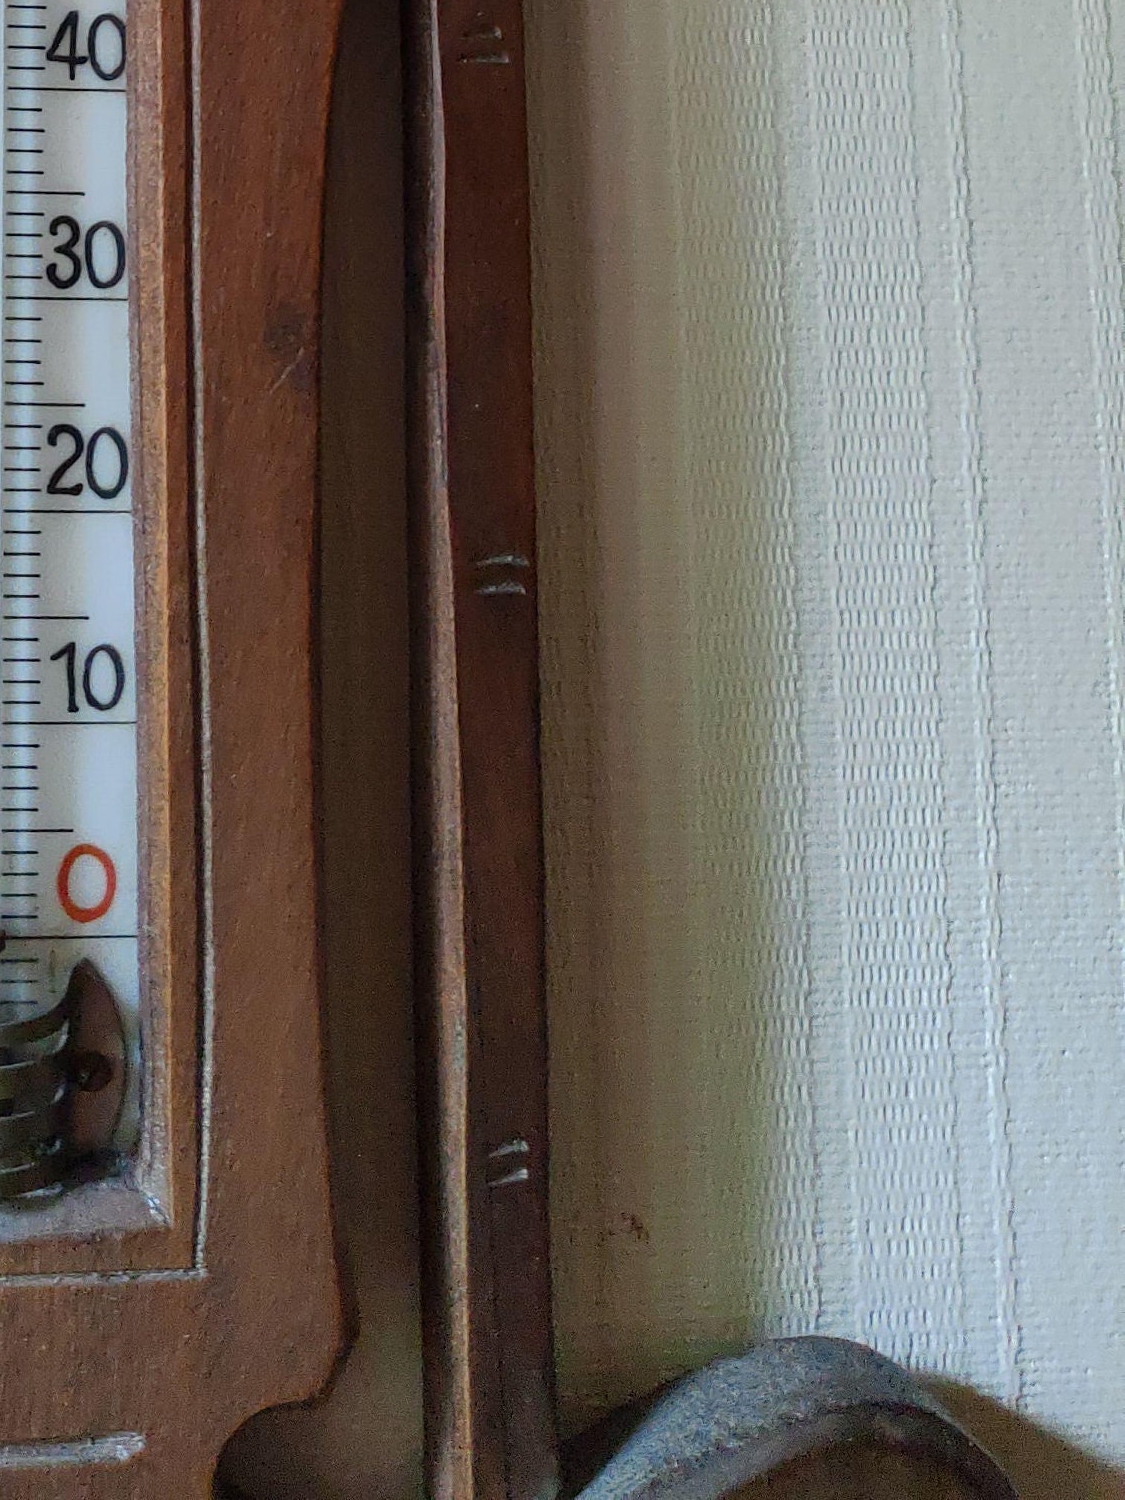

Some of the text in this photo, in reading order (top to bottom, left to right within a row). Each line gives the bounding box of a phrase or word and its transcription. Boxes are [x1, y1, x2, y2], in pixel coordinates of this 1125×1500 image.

[46, 10, 126, 81] 40
[46, 215, 126, 289] 30
[47, 424, 129, 499] 20
[50, 642, 125, 712] 10
[57, 843, 117, 923] 0
